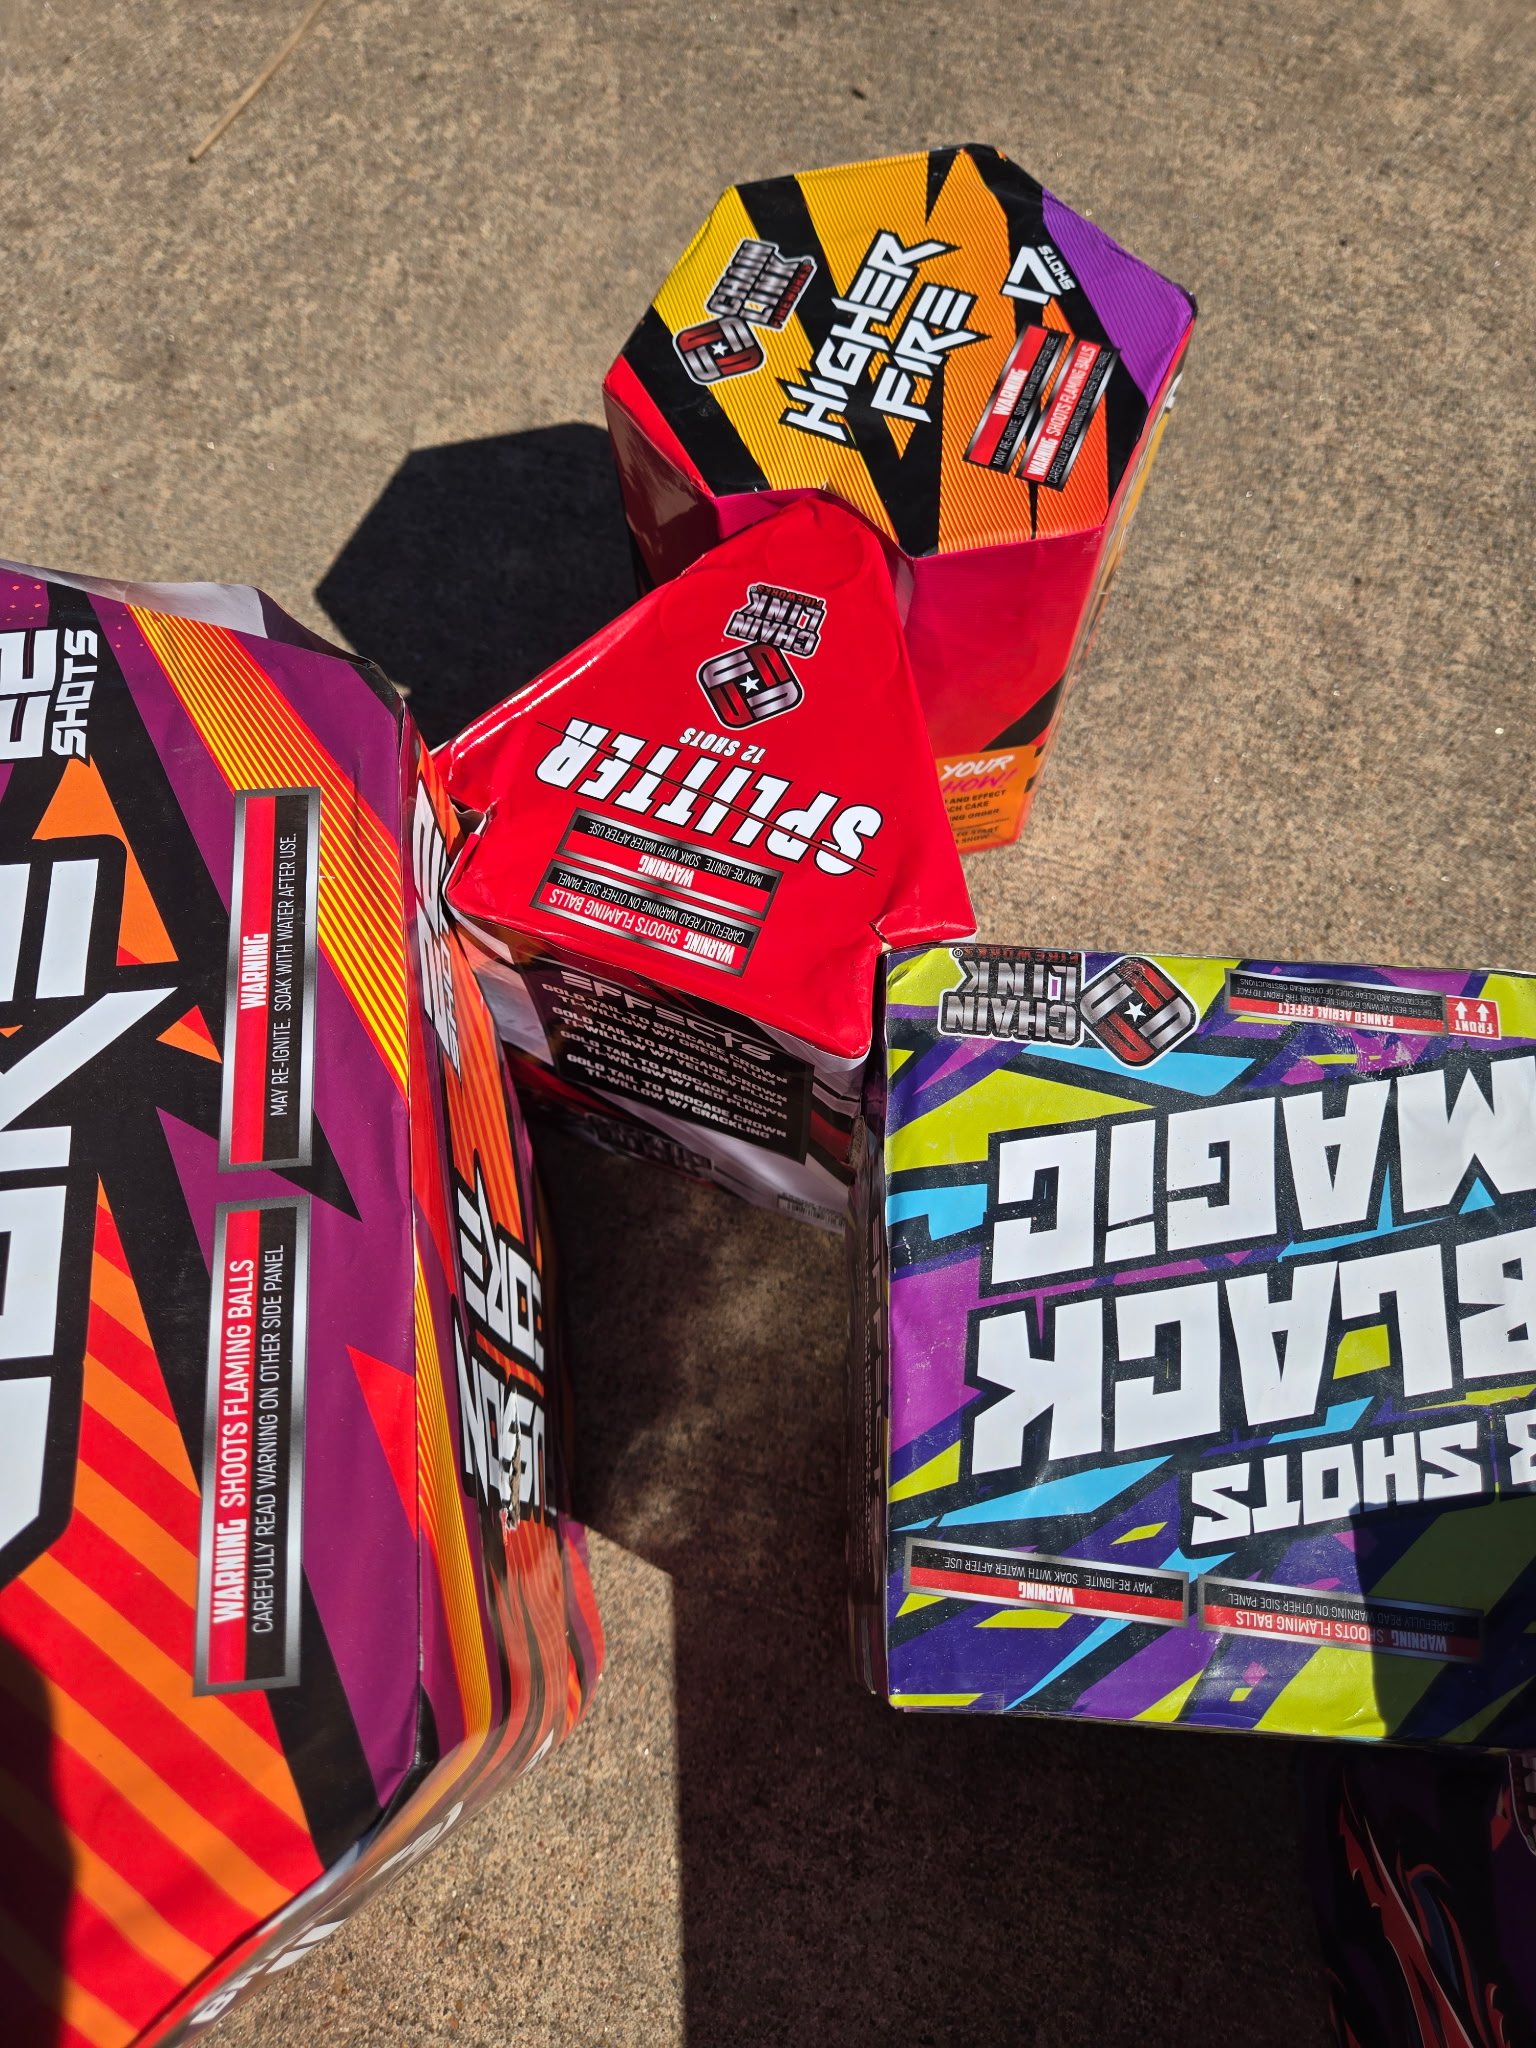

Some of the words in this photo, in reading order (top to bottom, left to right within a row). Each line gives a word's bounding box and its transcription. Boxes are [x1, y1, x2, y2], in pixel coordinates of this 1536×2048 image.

[709, 233, 774, 319] CHAIN
[1003, 246, 1060, 303] 17
[1037, 243, 1076, 291] SHOTS
[738, 251, 799, 328] LINK
[770, 261, 814, 328] FIREWORKS
[785, 232, 948, 440] HIGHER
[871, 284, 981, 422] FIRE
[992, 364, 1027, 419] WARNING
[1078, 396, 1090, 409] ON
[1026, 433, 1057, 479] WARNING
[1044, 399, 1072, 439] SHOOTS
[1058, 365, 1086, 406] FLAMING
[1074, 343, 1096, 372] BALLS
[1067, 406, 1086, 436] WARNING
[993, 449, 1007, 466] MAY
[1014, 399, 1029, 418] SOAK
[1060, 433, 1075, 451] READ
[1046, 449, 1068, 484] CAREFULLY
[742, 589, 822, 631] LINK
[728, 609, 816, 655] CHAIN
[51, 628, 99, 759] SHOTS
[677, 724, 740, 758] SHOTS
[739, 742, 766, 766] 12
[937, 753, 1016, 781] YOUR
[537, 717, 883, 876] SPLITTER
[971, 789, 1006, 800] EFFECT
[604, 826, 631, 845] AFTER
[629, 834, 658, 853] WATER
[657, 843, 678, 860] WITH
[678, 849, 701, 867] SOAK
[278, 861, 296, 896] AFTER
[555, 871, 582, 890] PANEL
[637, 854, 695, 887] WARNING
[743, 870, 763, 886] MAY
[548, 887, 584, 912] BALLS
[581, 879, 601, 896] SIDE
[600, 885, 628, 905] OTHER
[627, 894, 641, 909] ON
[277, 899, 294, 940] WATER
[583, 898, 635, 929] FLAMING
[640, 899, 678, 921] WARNING
[678, 911, 701, 929] READ
[634, 915, 681, 945] SHOOTS
[699, 918, 745, 943] CAREFULLY
[275, 943, 293, 975] WITH
[682, 930, 736, 964] WARNING
[240, 932, 268, 1009] WARNING
[961, 960, 1076, 1001] LINK
[1239, 978, 1287, 989] OBSTRUCTIONS
[274, 977, 292, 1011] SOAK
[1235, 987, 1251, 995] FACE
[1262, 990, 1283, 999] FRONT
[1288, 983, 1323, 993] OVERHEAD
[1354, 991, 1375, 1000] CLEAR
[1392, 995, 1432, 1005] SPECTATORS
[558, 969, 775, 1063] EFFECTS
[945, 995, 1077, 1040] CHAIN
[1276, 1002, 1313, 1017] EFFECT
[1316, 1006, 1351, 1021] AERIAL
[1353, 1010, 1393, 1026] FANNED
[1361, 1001, 1388, 1011] VIEWING
[1390, 1005, 1406, 1013] BEST
[541, 982, 585, 1002] GOLD
[589, 998, 623, 1015] TAIL
[625, 1012, 650, 1025] TO
[652, 1021, 726, 1055] BROCADE
[728, 1053, 788, 1083] CROWN
[1454, 1019, 1493, 1033] FRONT
[550, 1005, 592, 1024] GOLD
[594, 1020, 629, 1037] TAIL
[634, 1035, 656, 1048] TO
[657, 1044, 728, 1076] BROCADE
[728, 1074, 788, 1102] CROWN
[558, 1016, 646, 1051] TI-WILLOW
[674, 1057, 736, 1087] YELLOW
[739, 1084, 783, 1107] PLUM
[678, 1038, 729, 1063] GREEN
[730, 1062, 776, 1085] PLUM
[559, 1029, 600, 1048] GOLD
[601, 1044, 633, 1060] TAIL
[636, 1057, 660, 1070] TO
[660, 1066, 727, 1096] BROCADE
[728, 1092, 788, 1120] CROWN
[582, 1044, 666, 1079] TI-WILLOW
[668, 1075, 691, 1088] W/
[694, 1085, 724, 1101] RED
[725, 1097, 767, 1118] PLUM
[271, 1088, 288, 1116] MAY
[565, 1053, 606, 1072] GOLD
[606, 1067, 638, 1084] TAIL
[643, 1080, 663, 1092] TO
[663, 1087, 730, 1117] BROCADE
[732, 1113, 787, 1138] CROWN
[582, 1067, 664, 1101] TI-WILLOW
[665, 1096, 689, 1110] W/
[690, 1105, 771, 1140] CRACKLING
[991, 1055, 1536, 1284] MAGIC
[263, 1243, 284, 1291] PANEL
[227, 1258, 254, 1316] BALLS
[262, 1295, 282, 1328] SIDE
[260, 1332, 281, 1381] OTHER
[971, 1228, 1536, 1475] BLACK
[223, 1323, 253, 1415] FLAMING
[259, 1386, 280, 1409] ON
[218, 1420, 250, 1507] SHOOTS
[256, 1413, 279, 1488] WARNING
[1190, 1421, 1483, 1545] SHOTS
[254, 1492, 277, 1536] READ
[213, 1517, 247, 1624] WARNING
[964, 1559, 992, 1572] AFTER
[995, 1562, 1025, 1576] WATER
[1027, 1567, 1051, 1580] WITH
[1053, 1570, 1078, 1583] SOAK
[251, 1541, 275, 1633] CAREFULLY
[1017, 1581, 1074, 1604] WARNING
[1133, 1580, 1152, 1593] MAY
[1227, 1592, 1257, 1607] PANEL
[1260, 1597, 1280, 1610] SIDE
[1282, 1600, 1312, 1614] OTHER
[1315, 1604, 1329, 1616] ON
[1330, 1606, 1374, 1622] WARNING
[1234, 1610, 1272, 1628] BALLS
[1275, 1615, 1330, 1636] FLAMING
[1334, 1622, 1383, 1642] SHOOTS
[1390, 1629, 1447, 1651] WARNING
